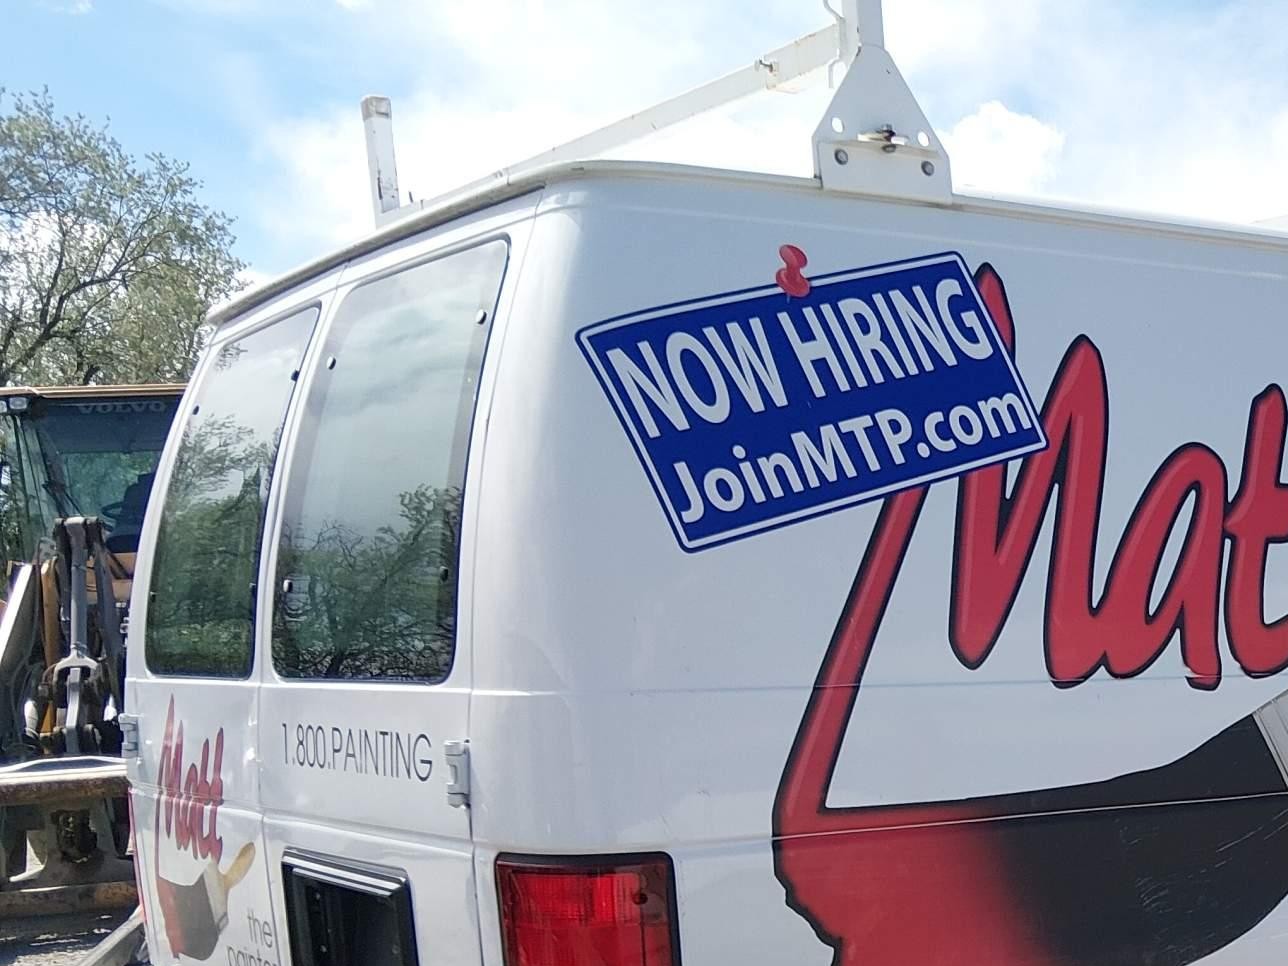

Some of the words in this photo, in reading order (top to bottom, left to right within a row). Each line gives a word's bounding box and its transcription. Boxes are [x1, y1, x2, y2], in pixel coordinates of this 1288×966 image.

[605, 317, 788, 438] NOW
[777, 278, 993, 397] HIRING
[79, 401, 168, 414] VOLVO
[673, 391, 1032, 523] JoinMTP.com
[157, 693, 224, 868] Matt
[281, 723, 433, 782] 1.800.PAINTING
[247, 910, 273, 948] the
